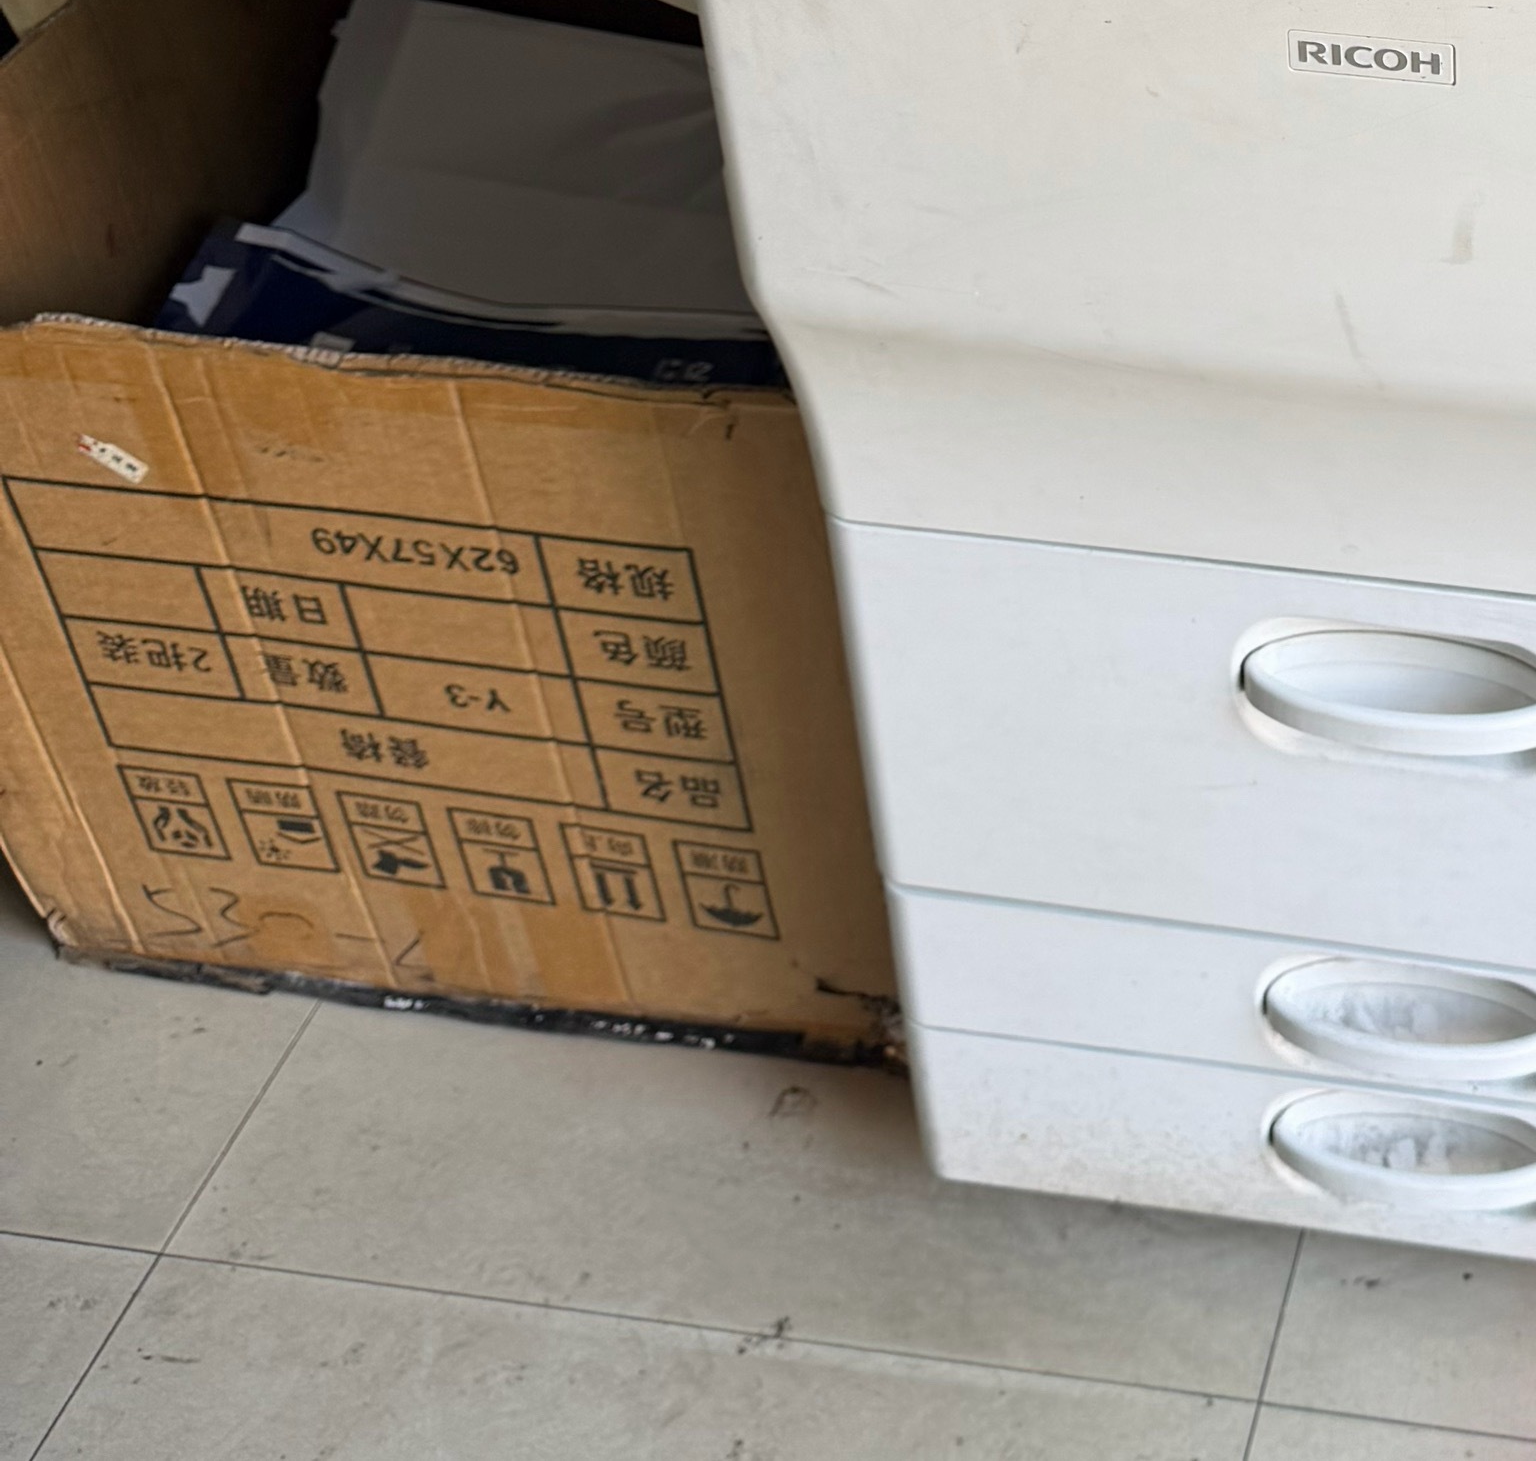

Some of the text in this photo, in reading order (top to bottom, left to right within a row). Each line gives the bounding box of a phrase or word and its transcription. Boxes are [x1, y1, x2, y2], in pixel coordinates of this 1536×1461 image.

[1297, 40, 1441, 75] RICOH
[310, 526, 520, 576] 62X57X49
[575, 558, 675, 601] 规格
[240, 585, 328, 626] 日期
[96, 631, 212, 673] 2把装
[591, 630, 691, 672] 颜色
[263, 653, 348, 694] 数量
[442, 683, 511, 713] Y-3
[614, 700, 707, 741] 型号
[338, 729, 429, 771] 餐椅
[634, 770, 722, 809] 品名
